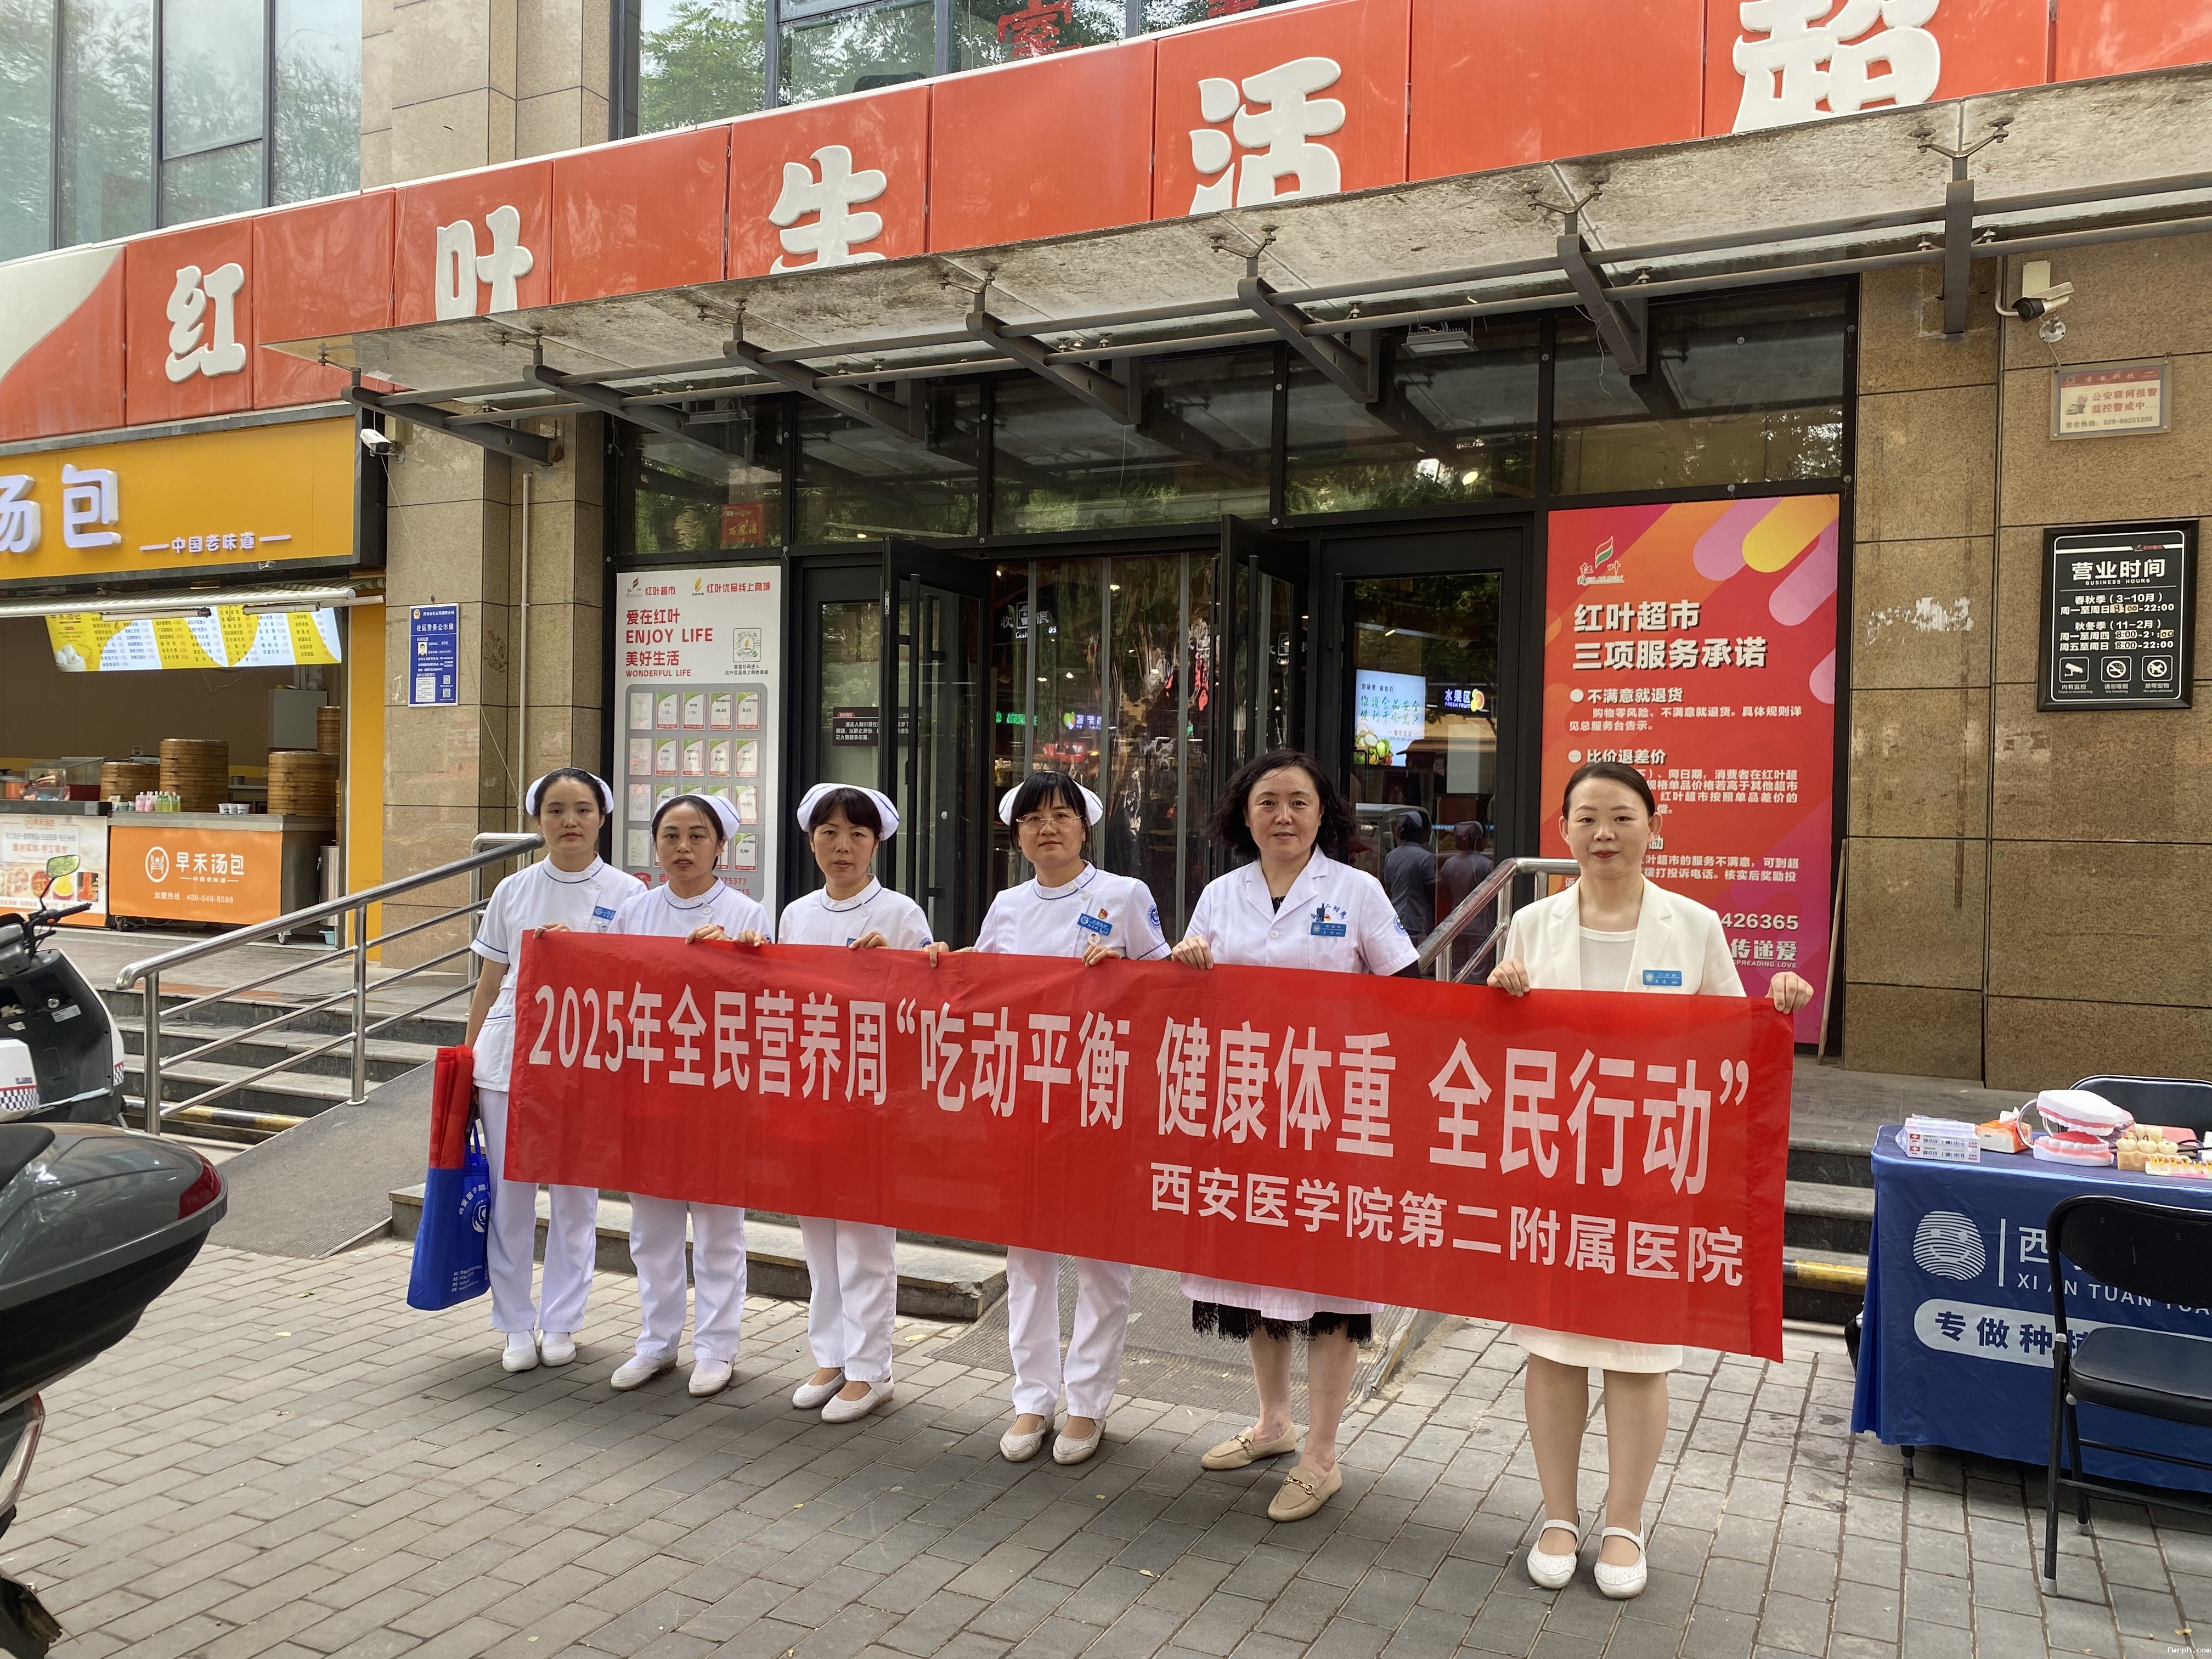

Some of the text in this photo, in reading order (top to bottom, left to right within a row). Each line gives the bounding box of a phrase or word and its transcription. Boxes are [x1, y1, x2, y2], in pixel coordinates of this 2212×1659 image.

[2092, 387, 2158, 402] 公安联网报警
[172, 532, 255, 554] 中国老味道
[2072, 558, 2165, 581] 营业时间
[645, 586, 675, 595] 红叶超市
[707, 582, 771, 593] 红叶优品线上商城
[627, 608, 681, 625] 爱在红叶
[1573, 599, 1701, 633] 红叶超市
[416, 623, 454, 631] 社区警务公示牌
[626, 628, 713, 645] ENJOY LIFE
[2060, 631, 2109, 641] 周一至周四
[1573, 636, 1767, 670] 三项服务承诺
[2059, 642, 2109, 651] 周五至周日
[626, 650, 680, 667] 美好生活
[1444, 688, 1471, 703] 水果区
[1588, 687, 1683, 704] 不满意就退货
[1569, 720, 1653, 732] 见总服务台告示。
[1587, 749, 1666, 765] 比价退差价
[1660, 792, 1798, 804] 红叶超市按照单品差价的
[176, 851, 245, 876] 早禾汤包
[1641, 854, 1799, 869] 叶超市的服务不满意，可到超
[1721, 912, 1798, 930] 426365
[1730, 938, 1797, 961] 传递爱
[1156, 1015, 1397, 1158] 健康体重
[1151, 1161, 1744, 1288] 西安医学院第二附属医院
[2017, 1273, 2038, 1290] XI
[2048, 1279, 2077, 1296] N
